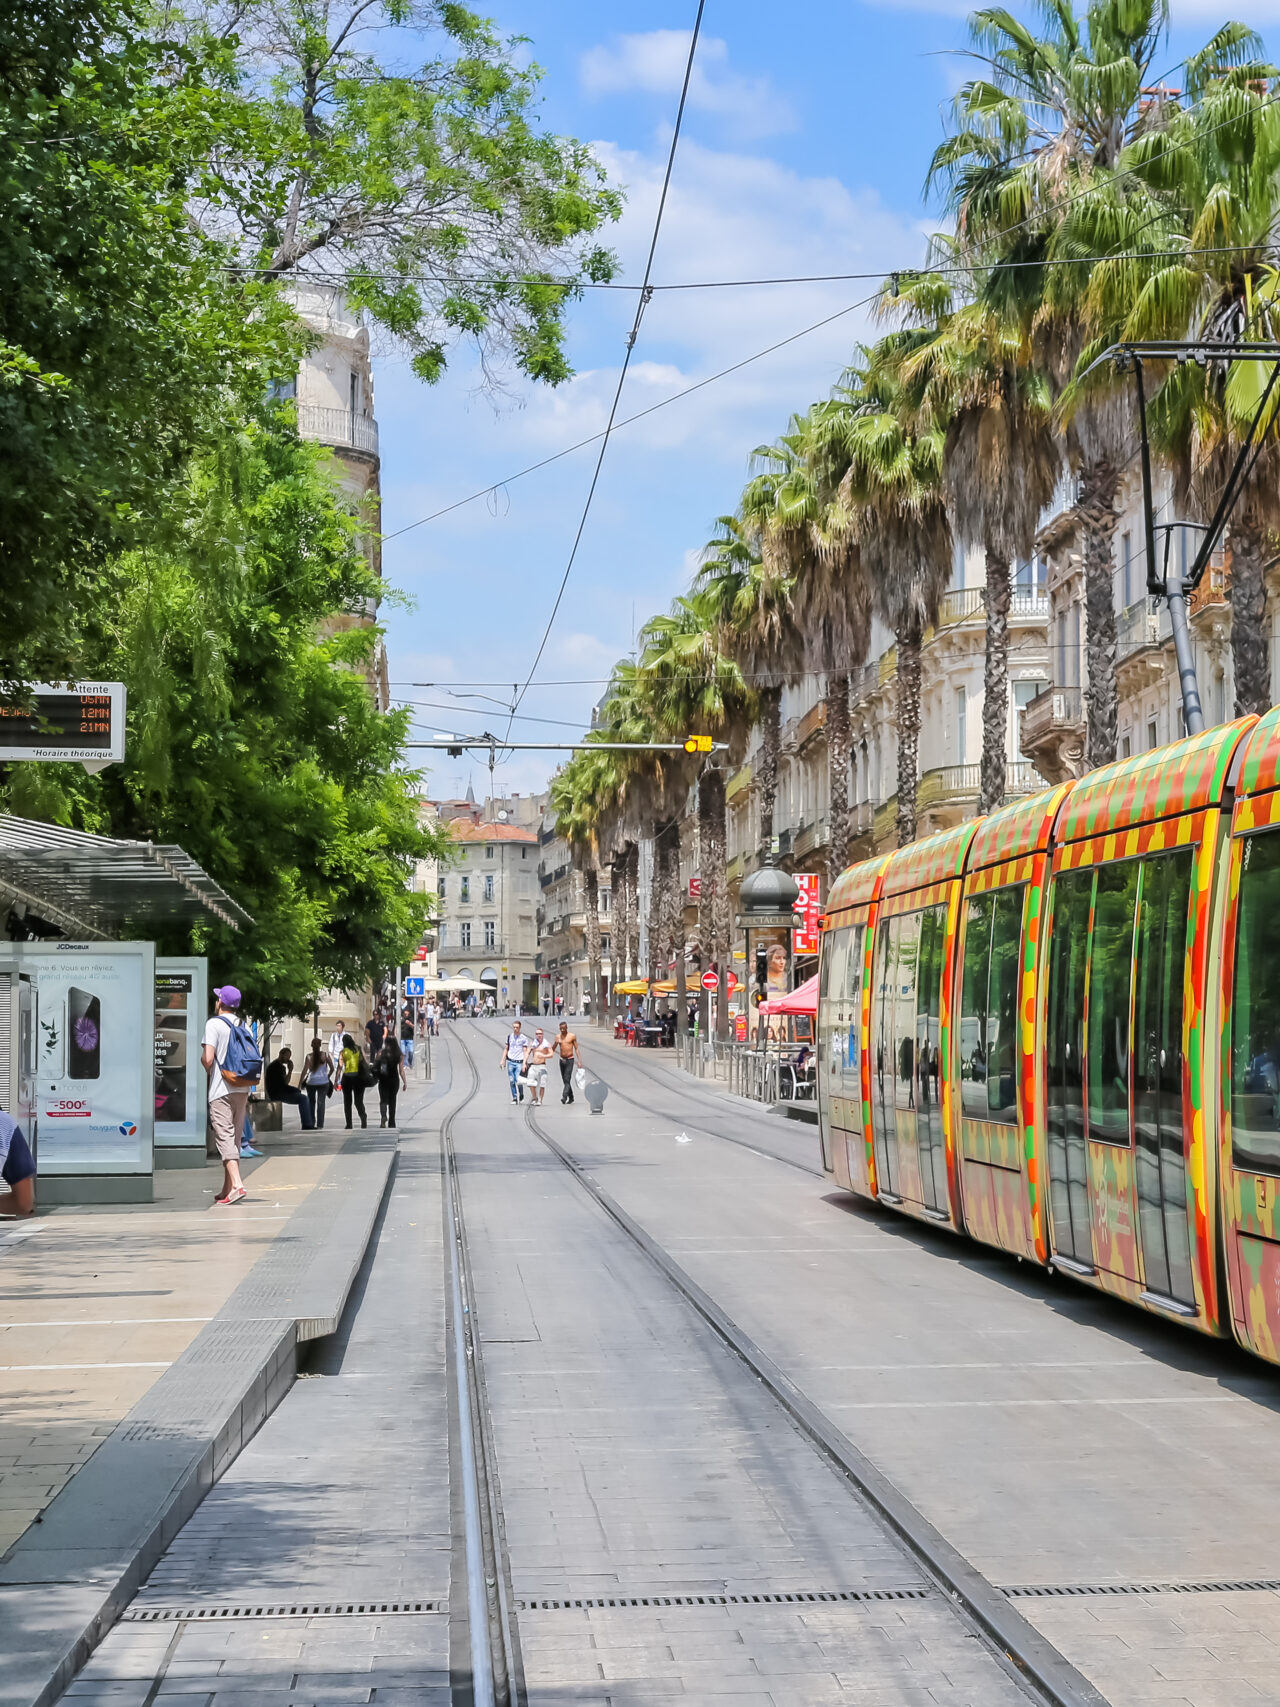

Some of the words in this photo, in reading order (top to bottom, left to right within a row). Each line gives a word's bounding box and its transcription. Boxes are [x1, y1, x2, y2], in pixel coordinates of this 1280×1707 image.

[72, 685, 109, 694] Attente
[80, 707, 110, 718] 12MN
[80, 722, 110, 733] 21MN
